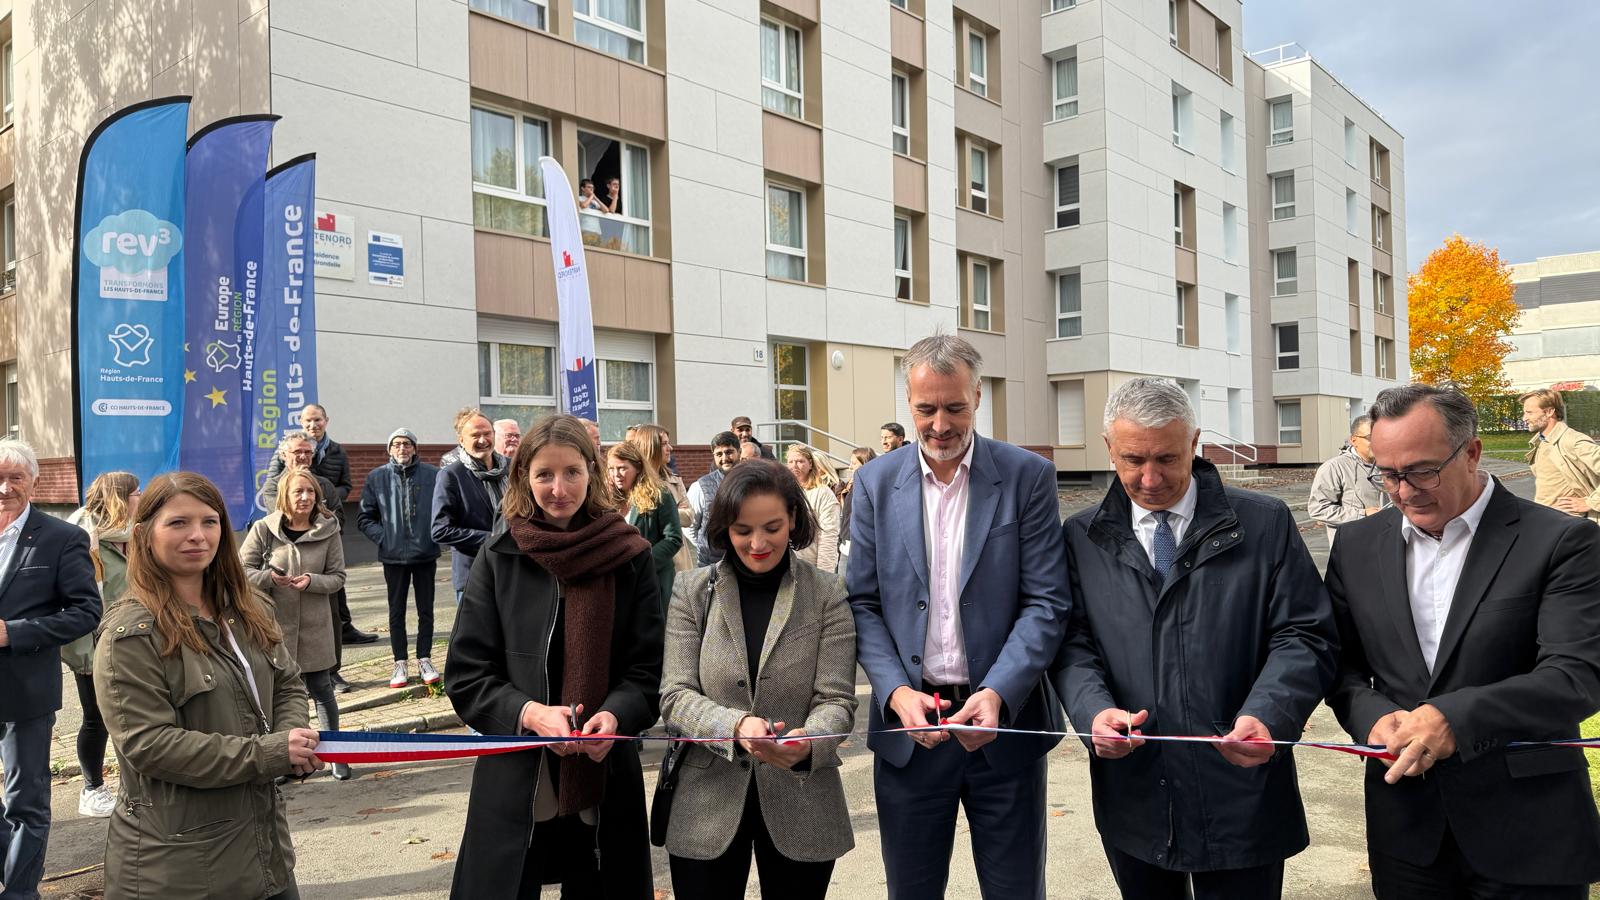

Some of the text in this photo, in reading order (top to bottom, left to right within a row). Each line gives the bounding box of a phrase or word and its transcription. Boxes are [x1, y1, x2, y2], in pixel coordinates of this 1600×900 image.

[314, 232, 352, 245] TENORD
[315, 252, 340, 260] sidence
[104, 279, 164, 289] TRANSFORMONS
[114, 287, 164, 295] HAUTS-DE-FRANCE
[215, 276, 233, 332] Europe
[232, 291, 243, 332] RÉGION
[242, 260, 258, 392] Hauts-de-France
[755, 350, 764, 359] 18
[100, 374, 164, 383] Hauts-de-France
[258, 369, 281, 449] Région
